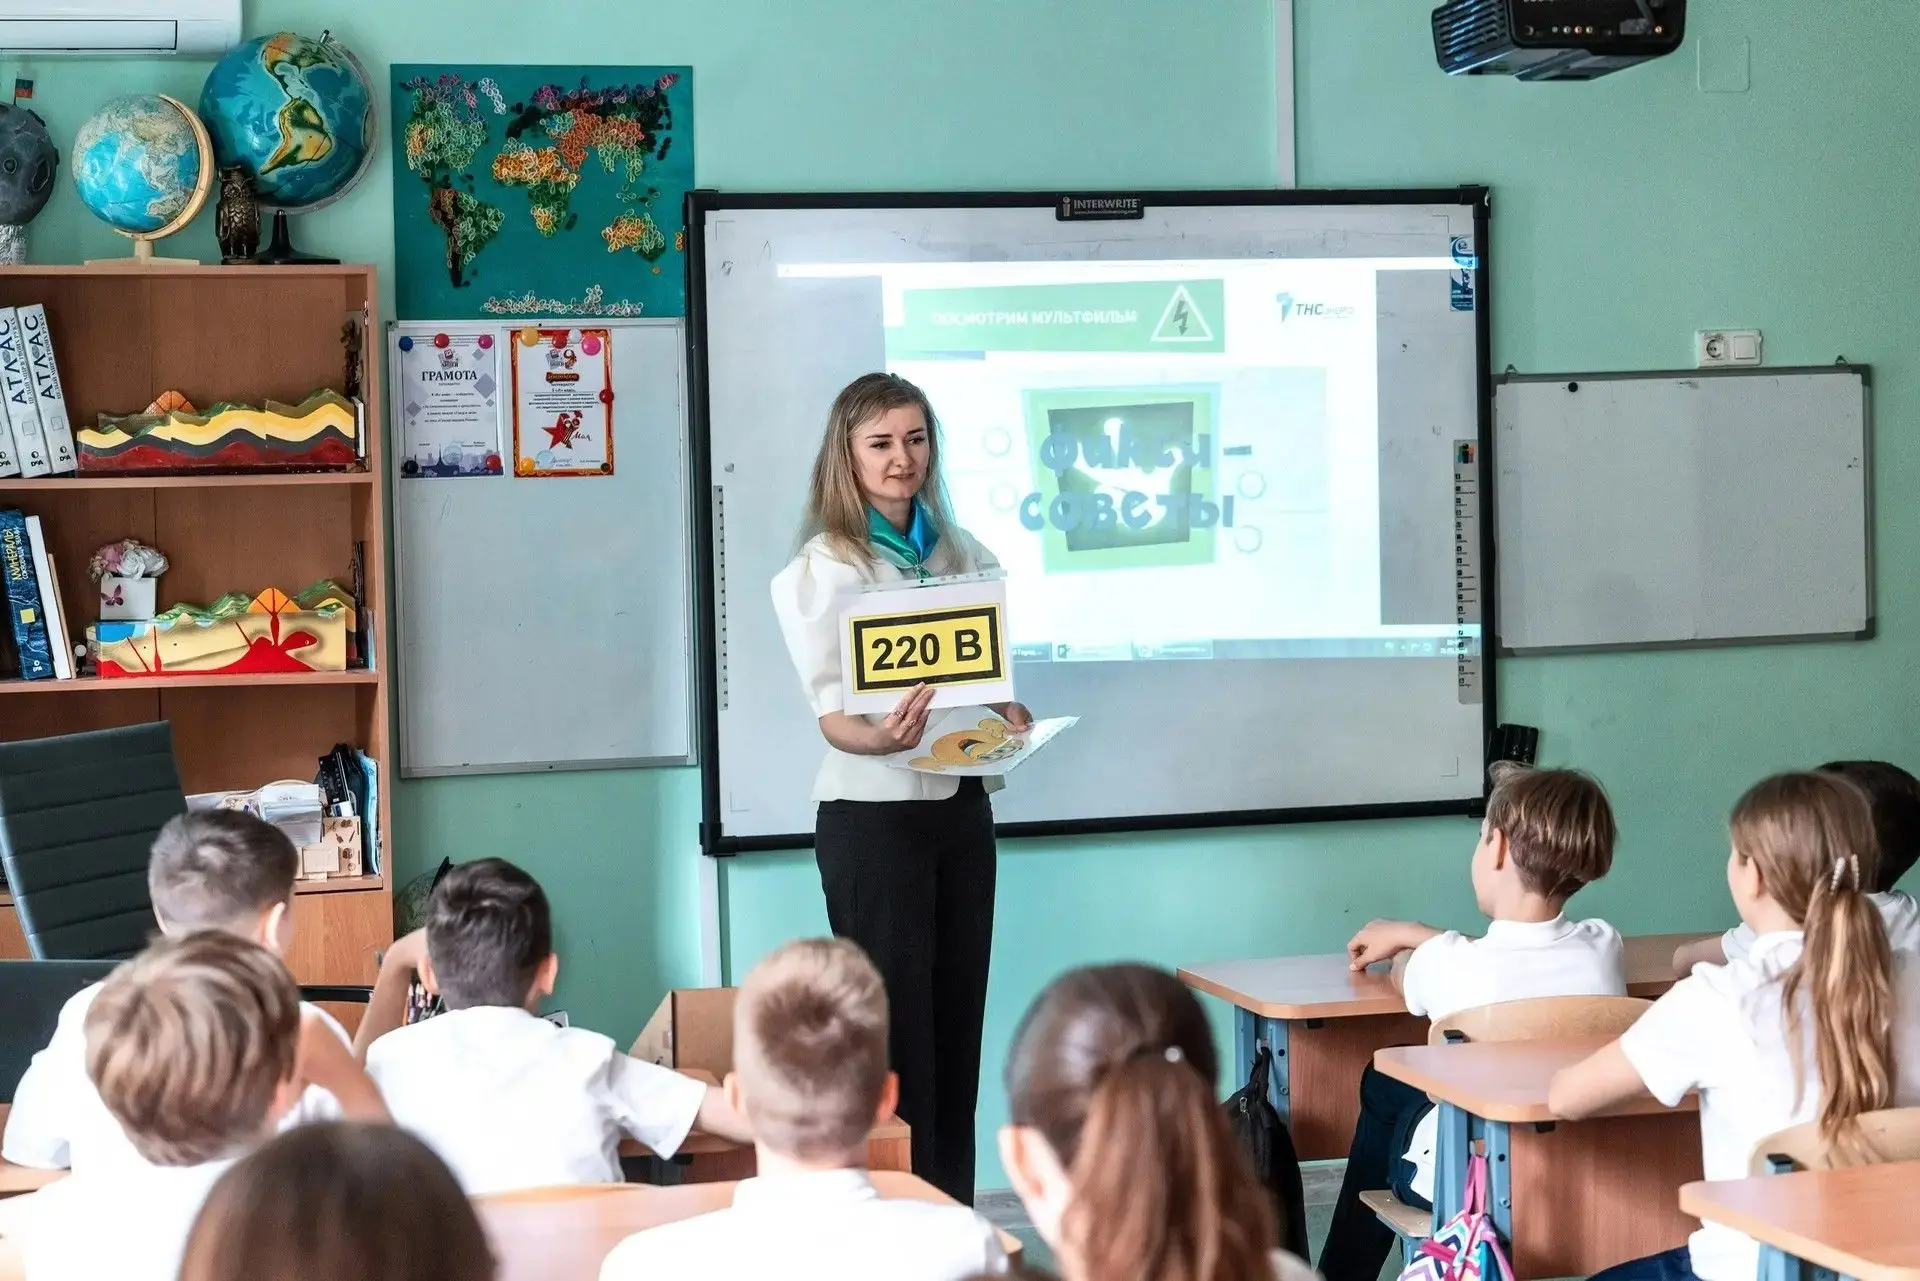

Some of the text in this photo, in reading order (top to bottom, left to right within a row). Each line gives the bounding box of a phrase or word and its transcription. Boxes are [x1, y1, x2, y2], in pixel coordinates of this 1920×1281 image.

[1073, 199, 1138, 209] INTERWRITE
[931, 309, 1137, 326] ПОСМОТРИМ МУЛЬТФИЛЬМ
[24, 315, 56, 400] АТЛАС
[421, 370, 478, 381] ГРАМОТА
[3, 529, 22, 581] МИНЕРАЛЫ
[871, 628, 983, 671] 220 В
